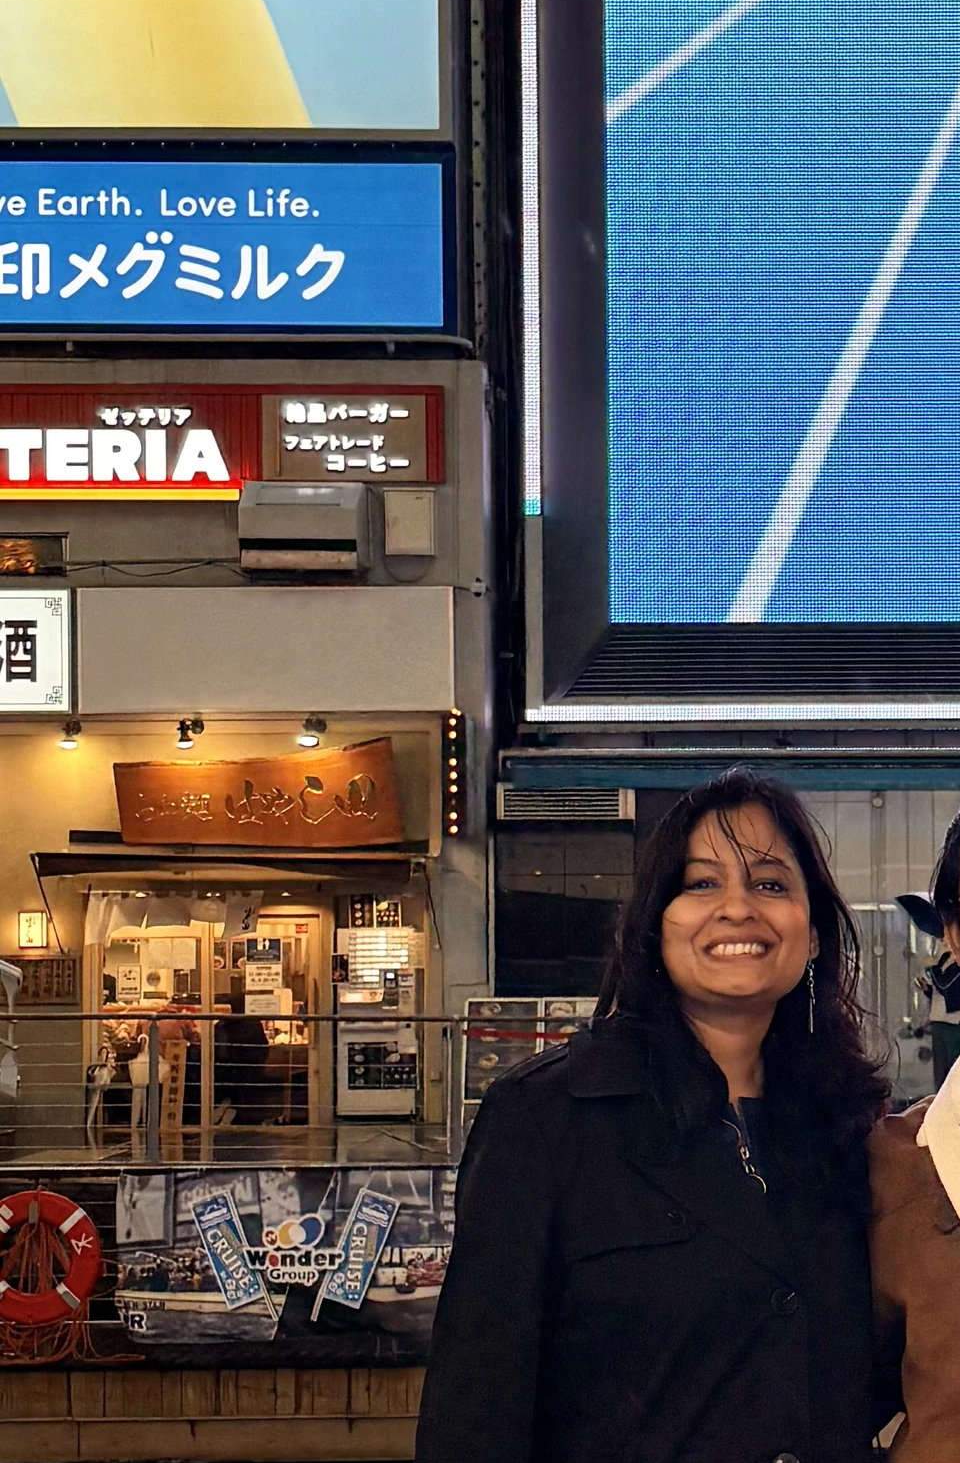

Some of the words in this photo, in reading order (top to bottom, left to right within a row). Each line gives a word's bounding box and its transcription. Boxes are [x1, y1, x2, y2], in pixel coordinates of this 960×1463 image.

[38, 187, 142, 217] Earth.
[160, 188, 236, 218] Love
[248, 188, 320, 218] Life.
[285, 435, 384, 451] フェアトレード
[327, 454, 410, 472] コーヒー
[206, 1228, 252, 1289] CRUISE
[346, 1223, 368, 1292] CRUISE
[269, 1270, 316, 1285] Group
